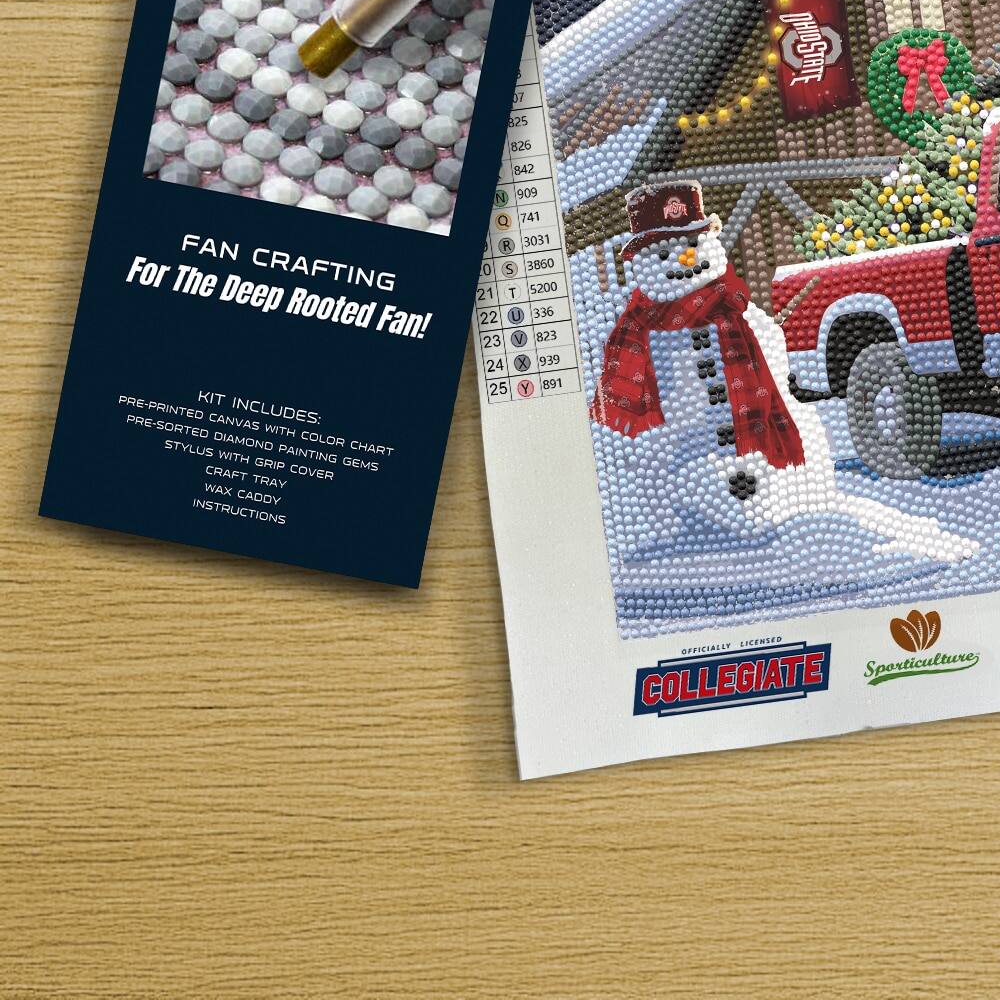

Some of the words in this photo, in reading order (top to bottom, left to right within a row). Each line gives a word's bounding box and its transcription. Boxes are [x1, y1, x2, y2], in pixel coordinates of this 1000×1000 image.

[508, 116, 528, 128] 825
[511, 140, 531, 151] 826
[514, 164, 534, 175] 842
[496, 192, 505, 203] N
[517, 187, 537, 199] 909
[498, 216, 508, 227] Q
[521, 212, 540, 223] 741
[503, 240, 510, 251] R
[524, 234, 550, 247] 3031
[182, 234, 239, 261] FAN
[252, 247, 396, 291] CRAFTING
[506, 264, 513, 275] S
[527, 258, 554, 271] 3860
[126, 256, 171, 288] For
[173, 264, 218, 297] The
[220, 274, 284, 312] Deep
[286, 287, 377, 328] Rooted
[376, 304, 432, 338] Fan!
[477, 288, 492, 300] 21
[509, 288, 516, 298] T
[530, 282, 557, 294] 5200
[480, 311, 498, 324] 22
[512, 310, 520, 322] U
[533, 306, 554, 318] 336
[484, 335, 501, 348] 23
[515, 334, 524, 345] V
[536, 330, 557, 343] 823
[486, 359, 504, 372] 24
[519, 357, 527, 369] X
[539, 354, 560, 366] 939
[490, 382, 508, 396] 25
[522, 383, 529, 394] Y
[543, 378, 562, 390] 891
[198, 391, 226, 406] KIT
[232, 397, 322, 424] INCLUDES:
[119, 396, 203, 419] PRE-PRINTED
[209, 413, 260, 430] CANVAS
[265, 424, 295, 438] WITH
[301, 431, 344, 447] COLOR
[351, 441, 394, 456] CHART
[126, 414, 208, 438] PRE-SORTED
[214, 432, 273, 450] DIAMOND
[278, 444, 337, 463] PAINTING
[343, 457, 378, 471] GEMS
[165, 440, 213, 457] STYLUS
[219, 450, 249, 464] WITH
[255, 458, 285, 470] GRIP
[290, 464, 334, 480] COVER
[206, 466, 248, 480] CRAFT
[253, 474, 287, 488] TRAY
[204, 483, 232, 496] WAX
[238, 490, 281, 505] CADDY
[193, 499, 286, 524] INSTRUCTIONS
[682, 642, 731, 655] OFFICIALLY
[740, 636, 782, 648] LICENSED
[864, 652, 976, 677] Sporticulture
[642, 652, 825, 706] COLLEGIATE
